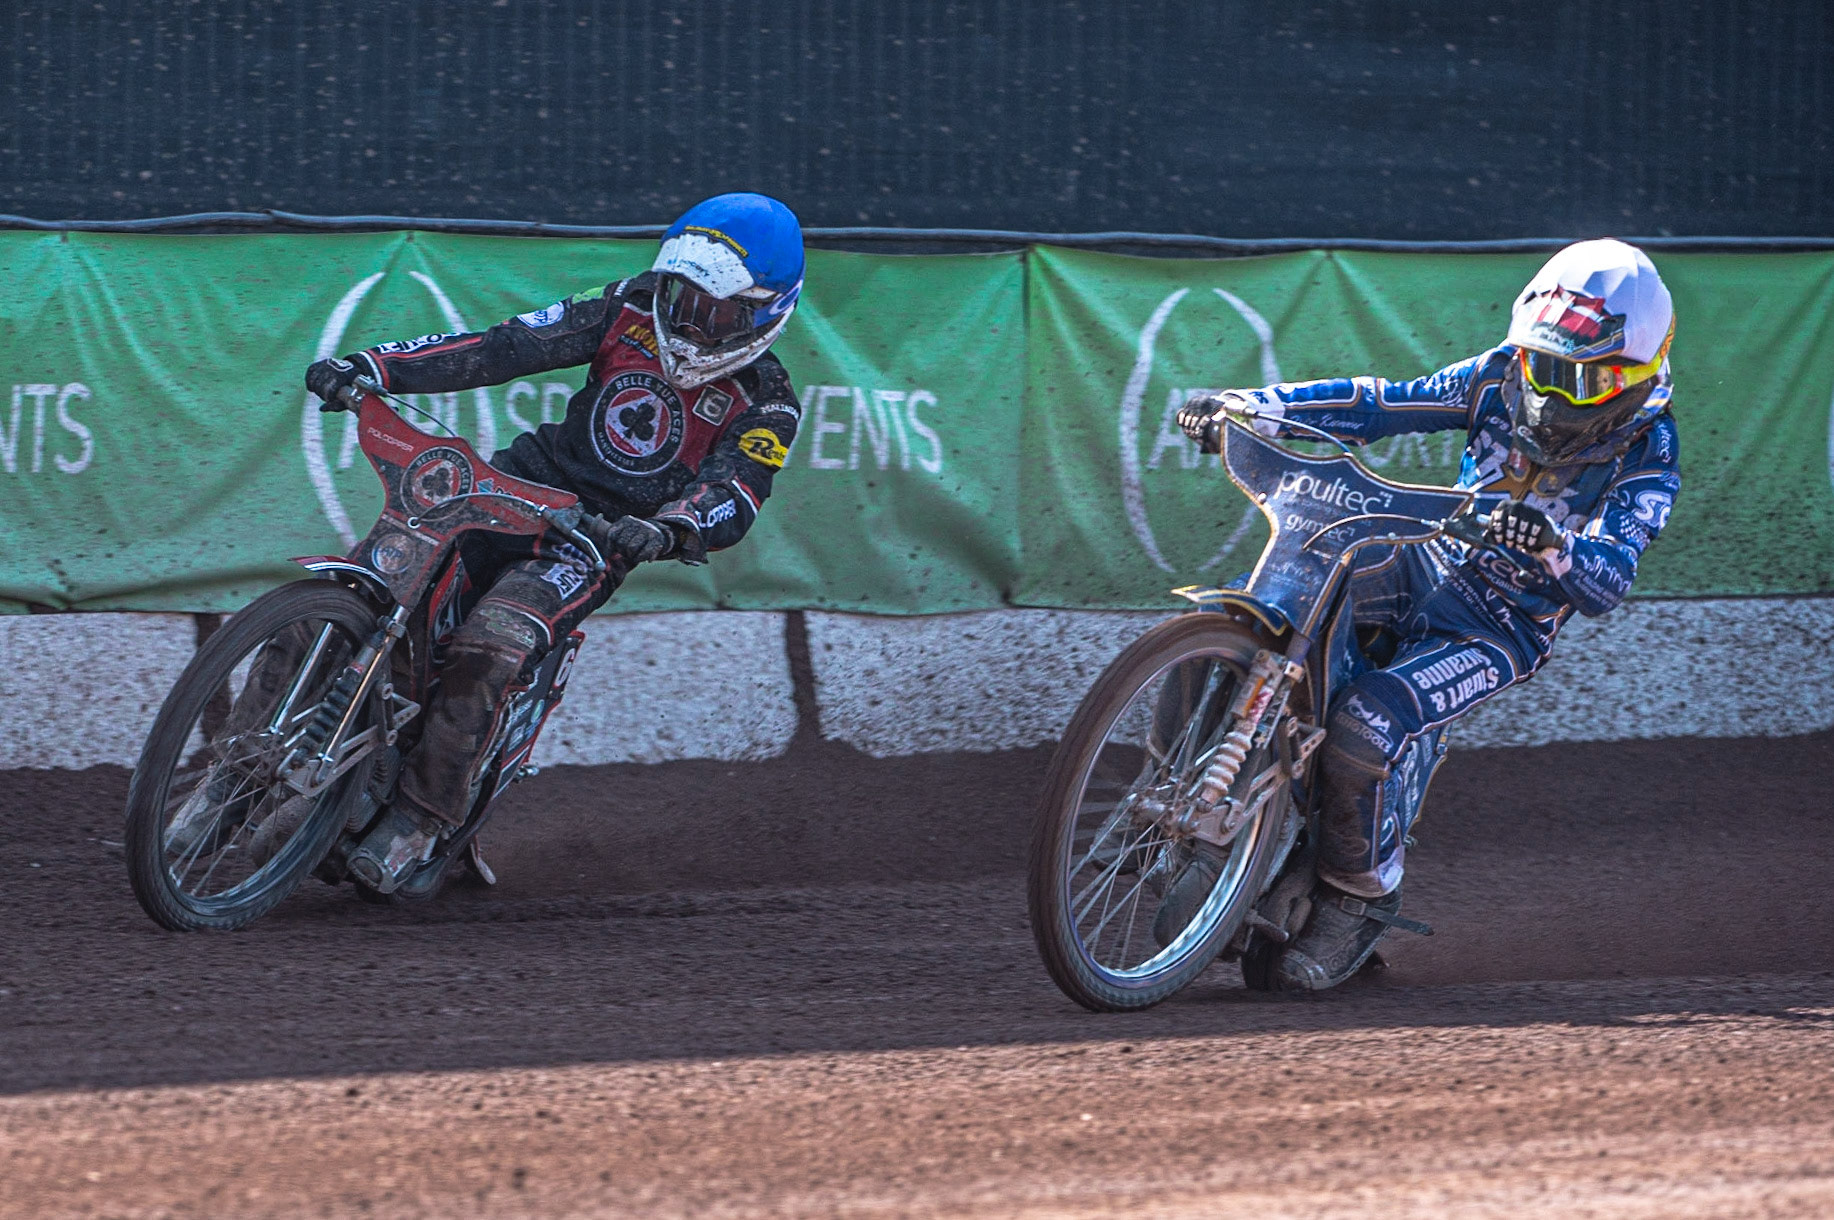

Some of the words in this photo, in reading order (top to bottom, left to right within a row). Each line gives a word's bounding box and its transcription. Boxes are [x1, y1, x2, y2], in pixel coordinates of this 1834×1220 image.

[615, 376, 652, 390] BELLE
[656, 384, 677, 405] VUE
[671, 410, 682, 443] ACES
[1273, 469, 1382, 515] poultec
[1411, 647, 1492, 690] Suzanne
[1450, 666, 1500, 709] Stuart
[1429, 690, 1447, 713] &
